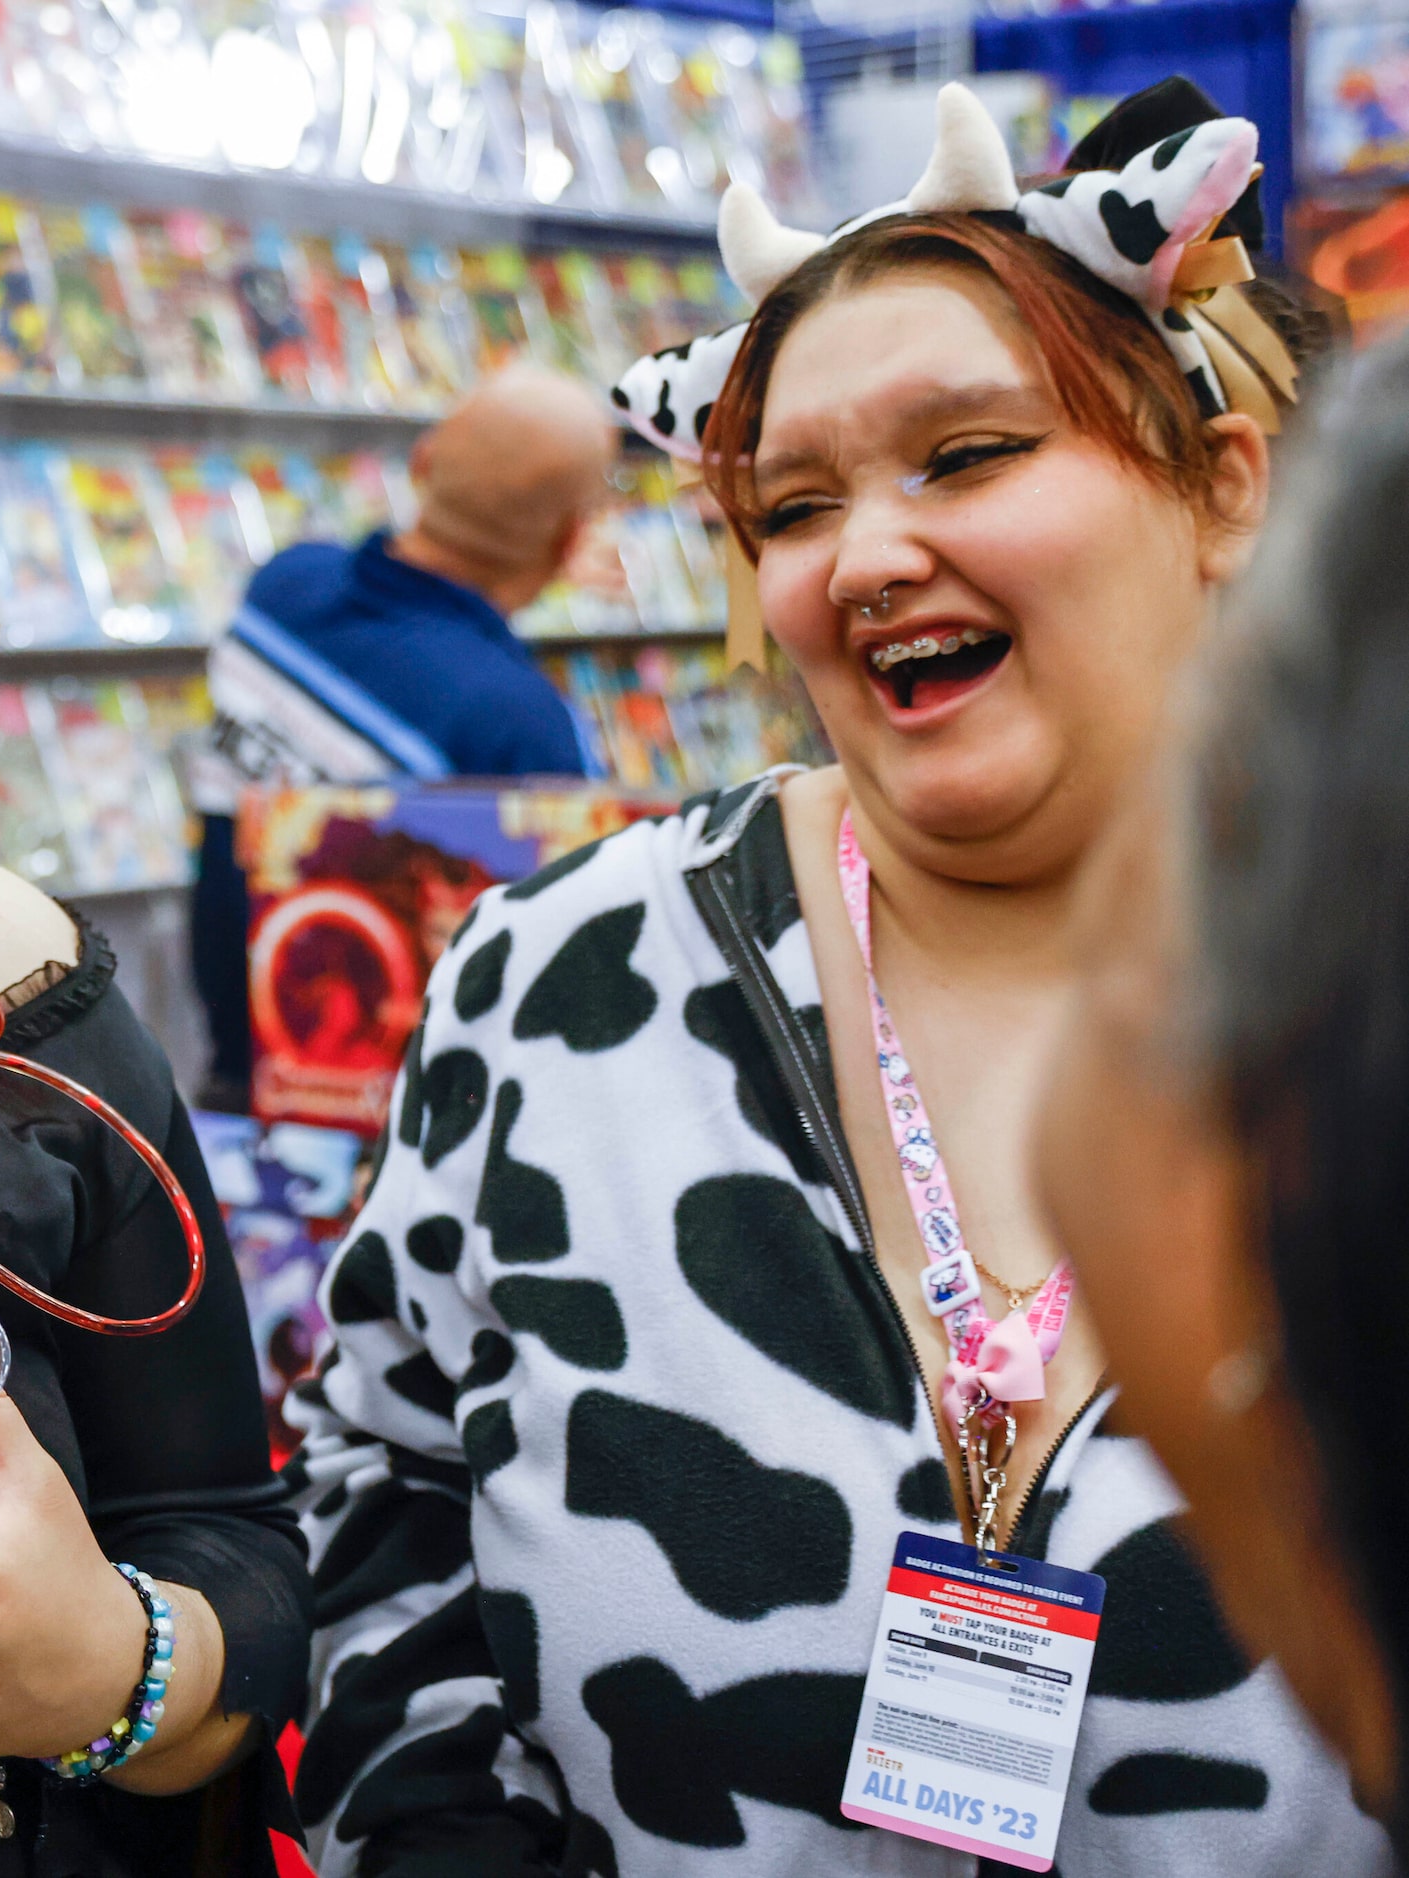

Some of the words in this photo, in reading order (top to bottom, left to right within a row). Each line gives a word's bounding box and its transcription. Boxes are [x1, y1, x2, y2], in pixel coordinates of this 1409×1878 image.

[905, 1556, 931, 1569] BADGE
[1023, 1583, 1033, 1594] TO
[1058, 1592, 1084, 1606] EVENT
[919, 1606, 938, 1619] YOU
[939, 1612, 964, 1626] MUST
[965, 1618, 982, 1630] TAP
[983, 1622, 1007, 1637] YOUR
[1009, 1628, 1040, 1645] BADGE
[1040, 1636, 1052, 1647] AT
[931, 1623, 946, 1635] ALL
[948, 1627, 999, 1647] ENTRANCES
[1008, 1641, 1034, 1656] EXITS
[862, 1770, 909, 1806] ALL
[915, 1783, 985, 1826] DAYS
